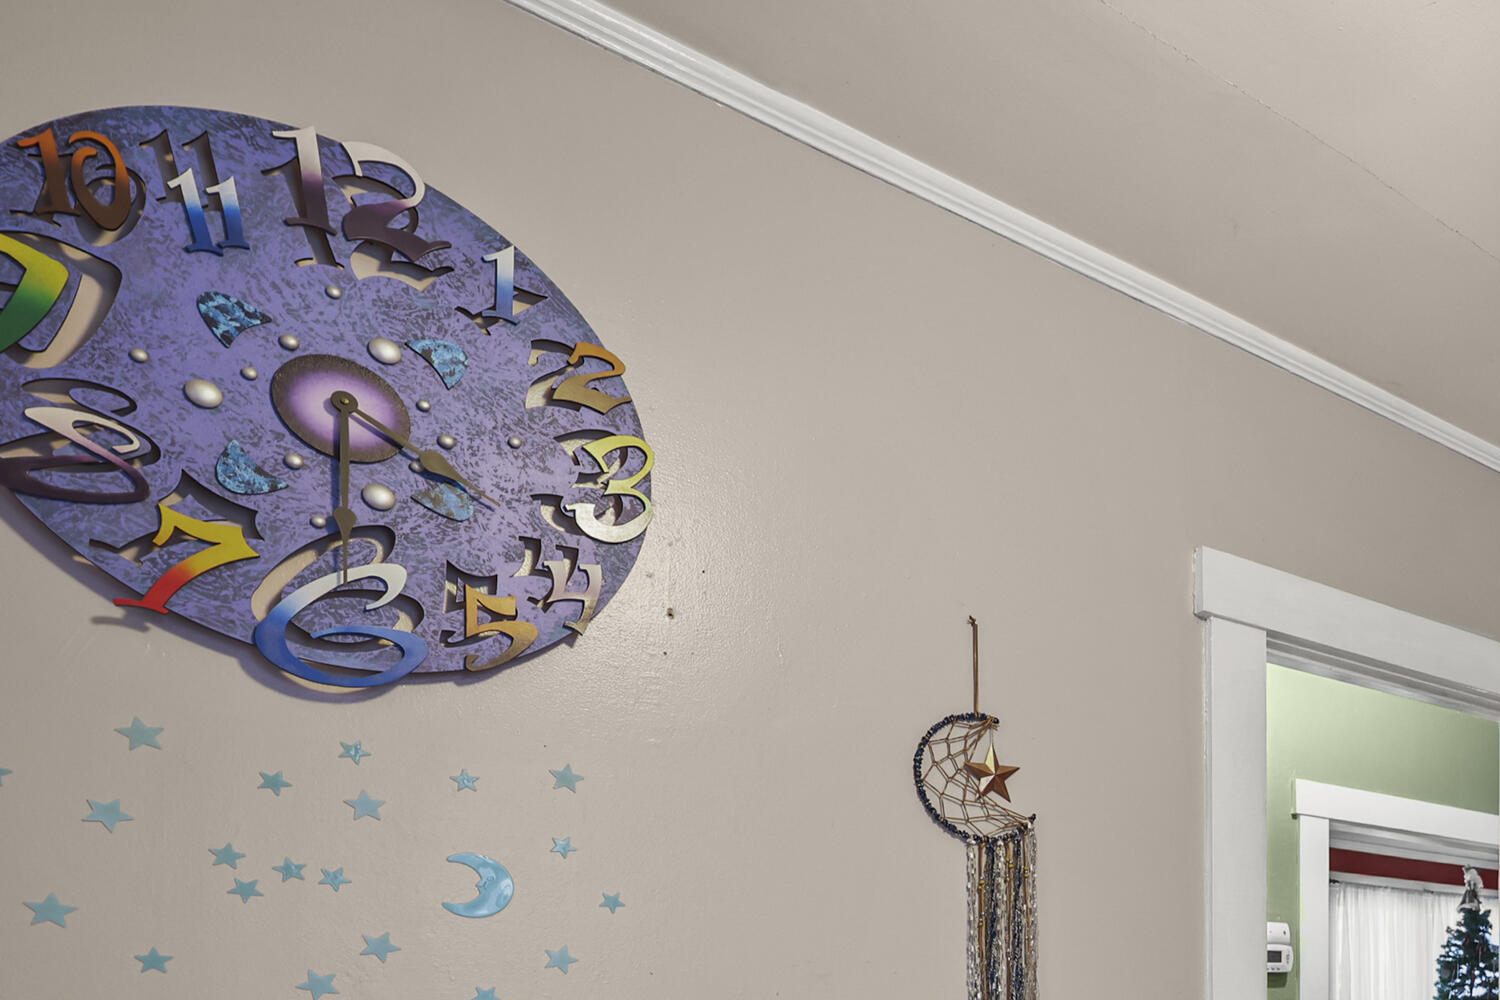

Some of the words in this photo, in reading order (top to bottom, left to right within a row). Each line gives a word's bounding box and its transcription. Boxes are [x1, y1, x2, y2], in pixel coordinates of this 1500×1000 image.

[17, 127, 132, 231] 10
[166, 166, 251, 257] 11
[272, 125, 453, 263] 12
[482, 245, 520, 326] 1
[552, 341, 632, 415] 2
[0, 405, 151, 505] 8
[563, 434, 655, 544] 3
[113, 502, 260, 614] 7
[541, 559, 603, 637] 4
[254, 562, 429, 688] 6
[464, 583, 540, 672] 5
